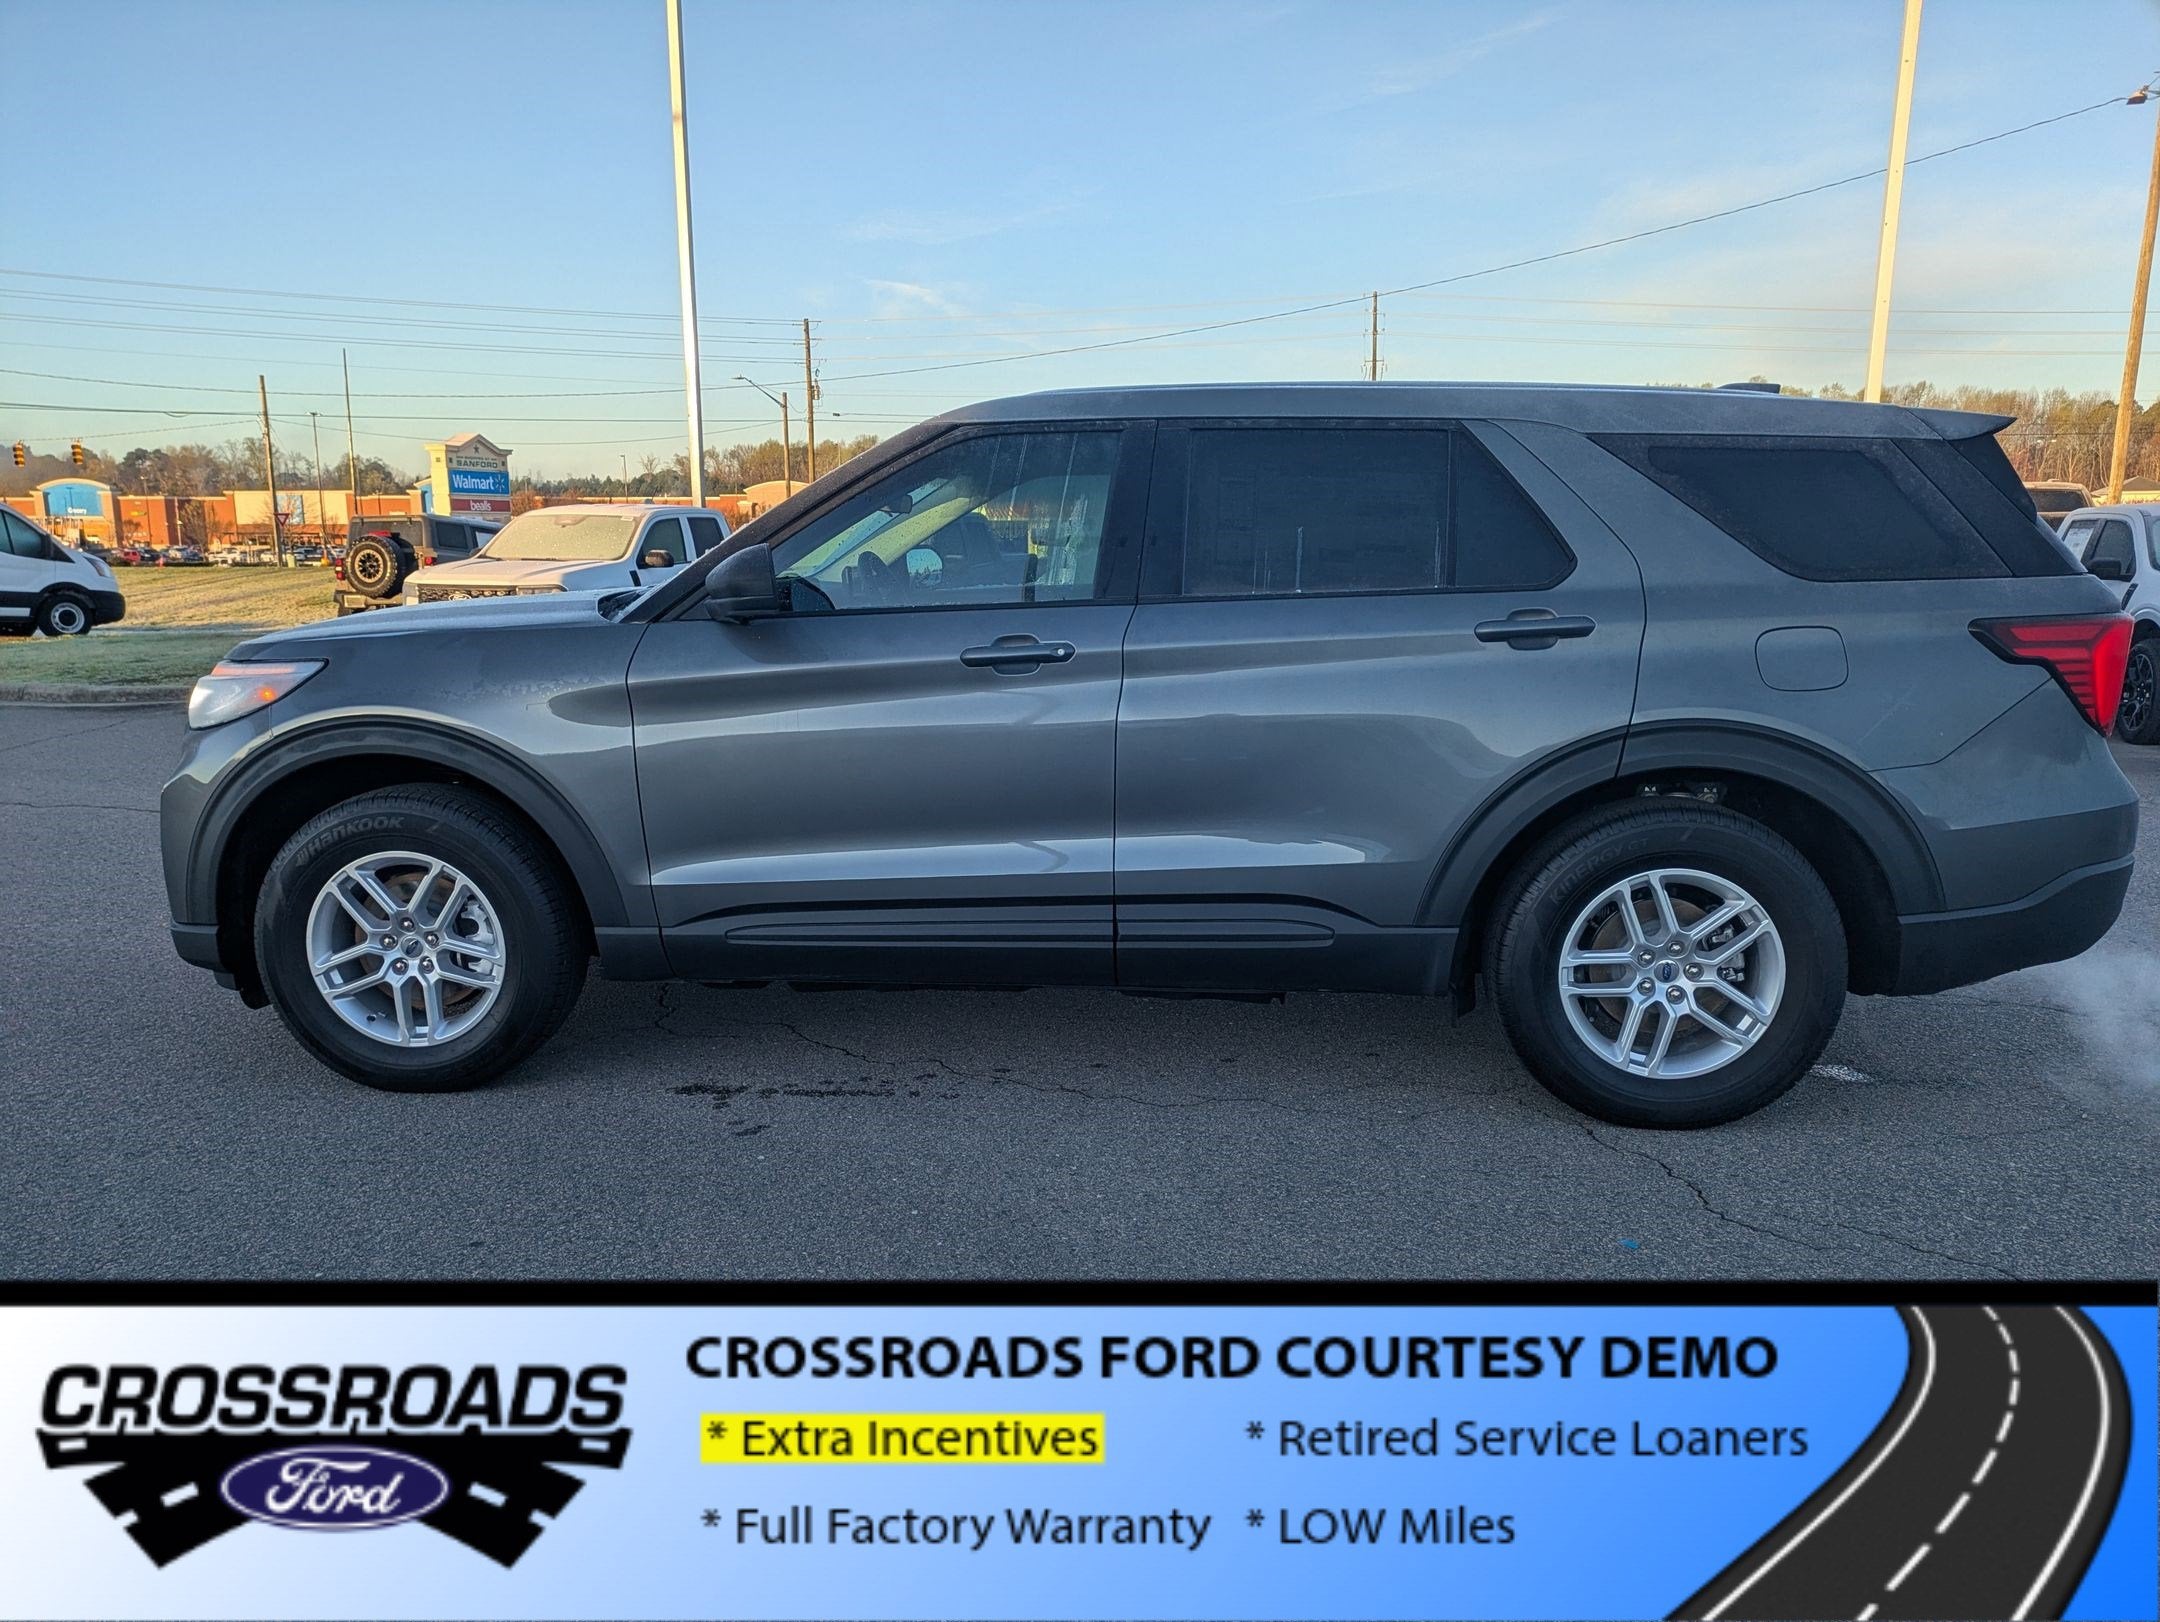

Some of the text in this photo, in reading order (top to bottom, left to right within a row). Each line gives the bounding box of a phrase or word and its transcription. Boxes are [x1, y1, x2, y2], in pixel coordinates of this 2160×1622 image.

[456, 459, 498, 469] SANFORD
[452, 474, 494, 490] Walmart
[470, 500, 491, 511] bealls
